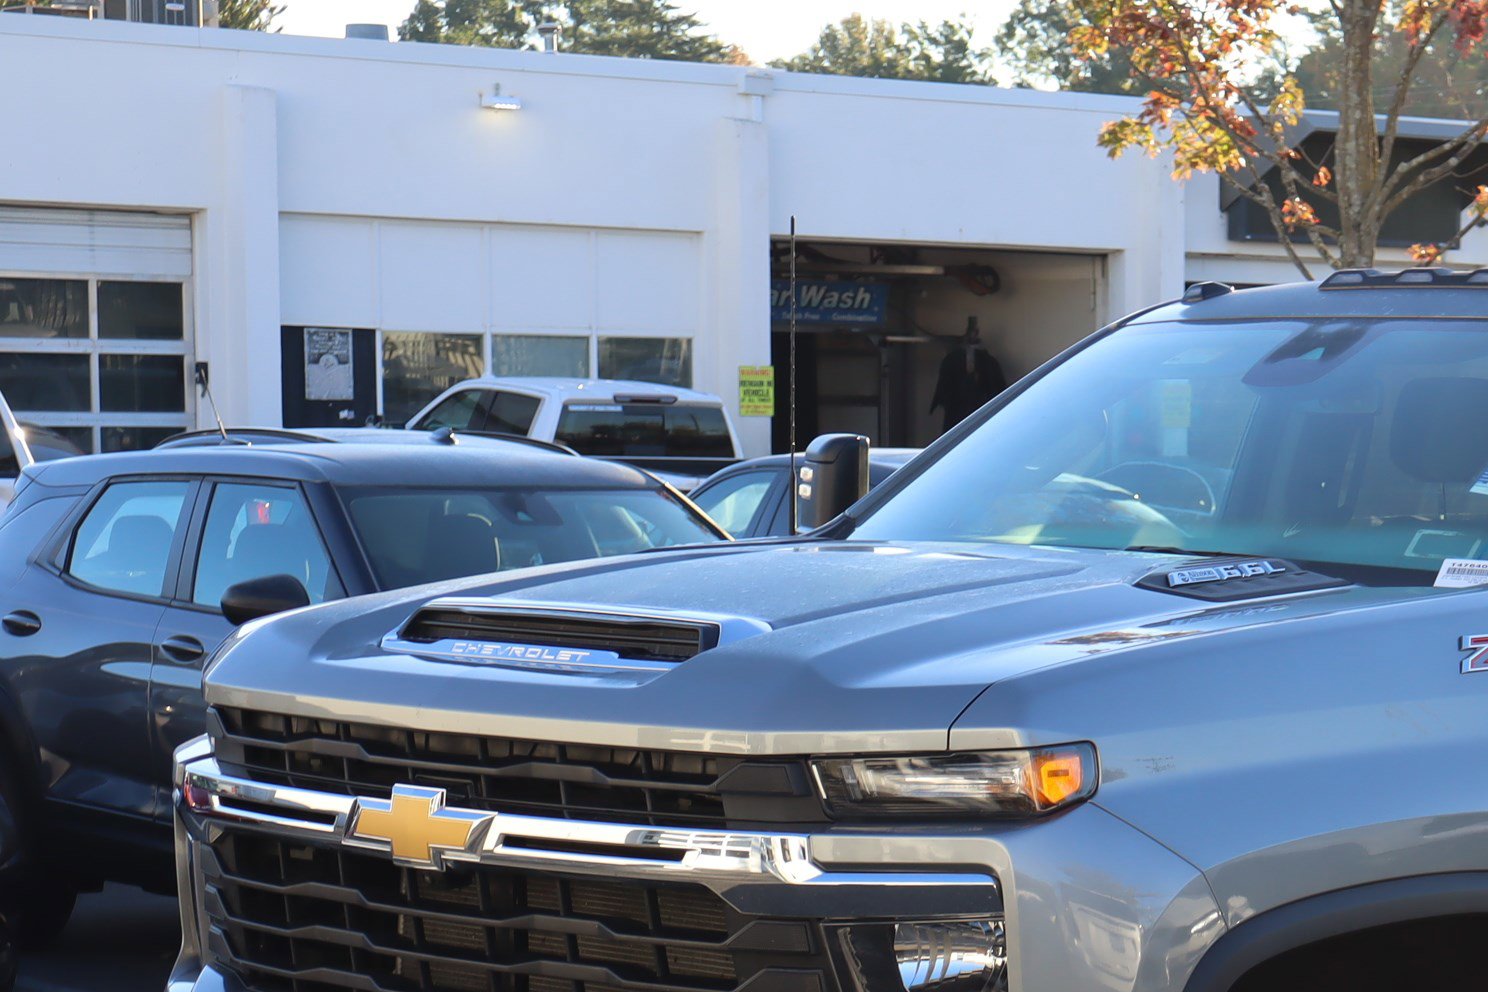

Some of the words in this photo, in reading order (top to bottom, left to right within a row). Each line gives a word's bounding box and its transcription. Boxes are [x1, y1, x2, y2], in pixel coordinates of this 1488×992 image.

[771, 289, 792, 306] ar
[800, 285, 871, 308] Wash
[451, 642, 590, 662] CHEVROLET
